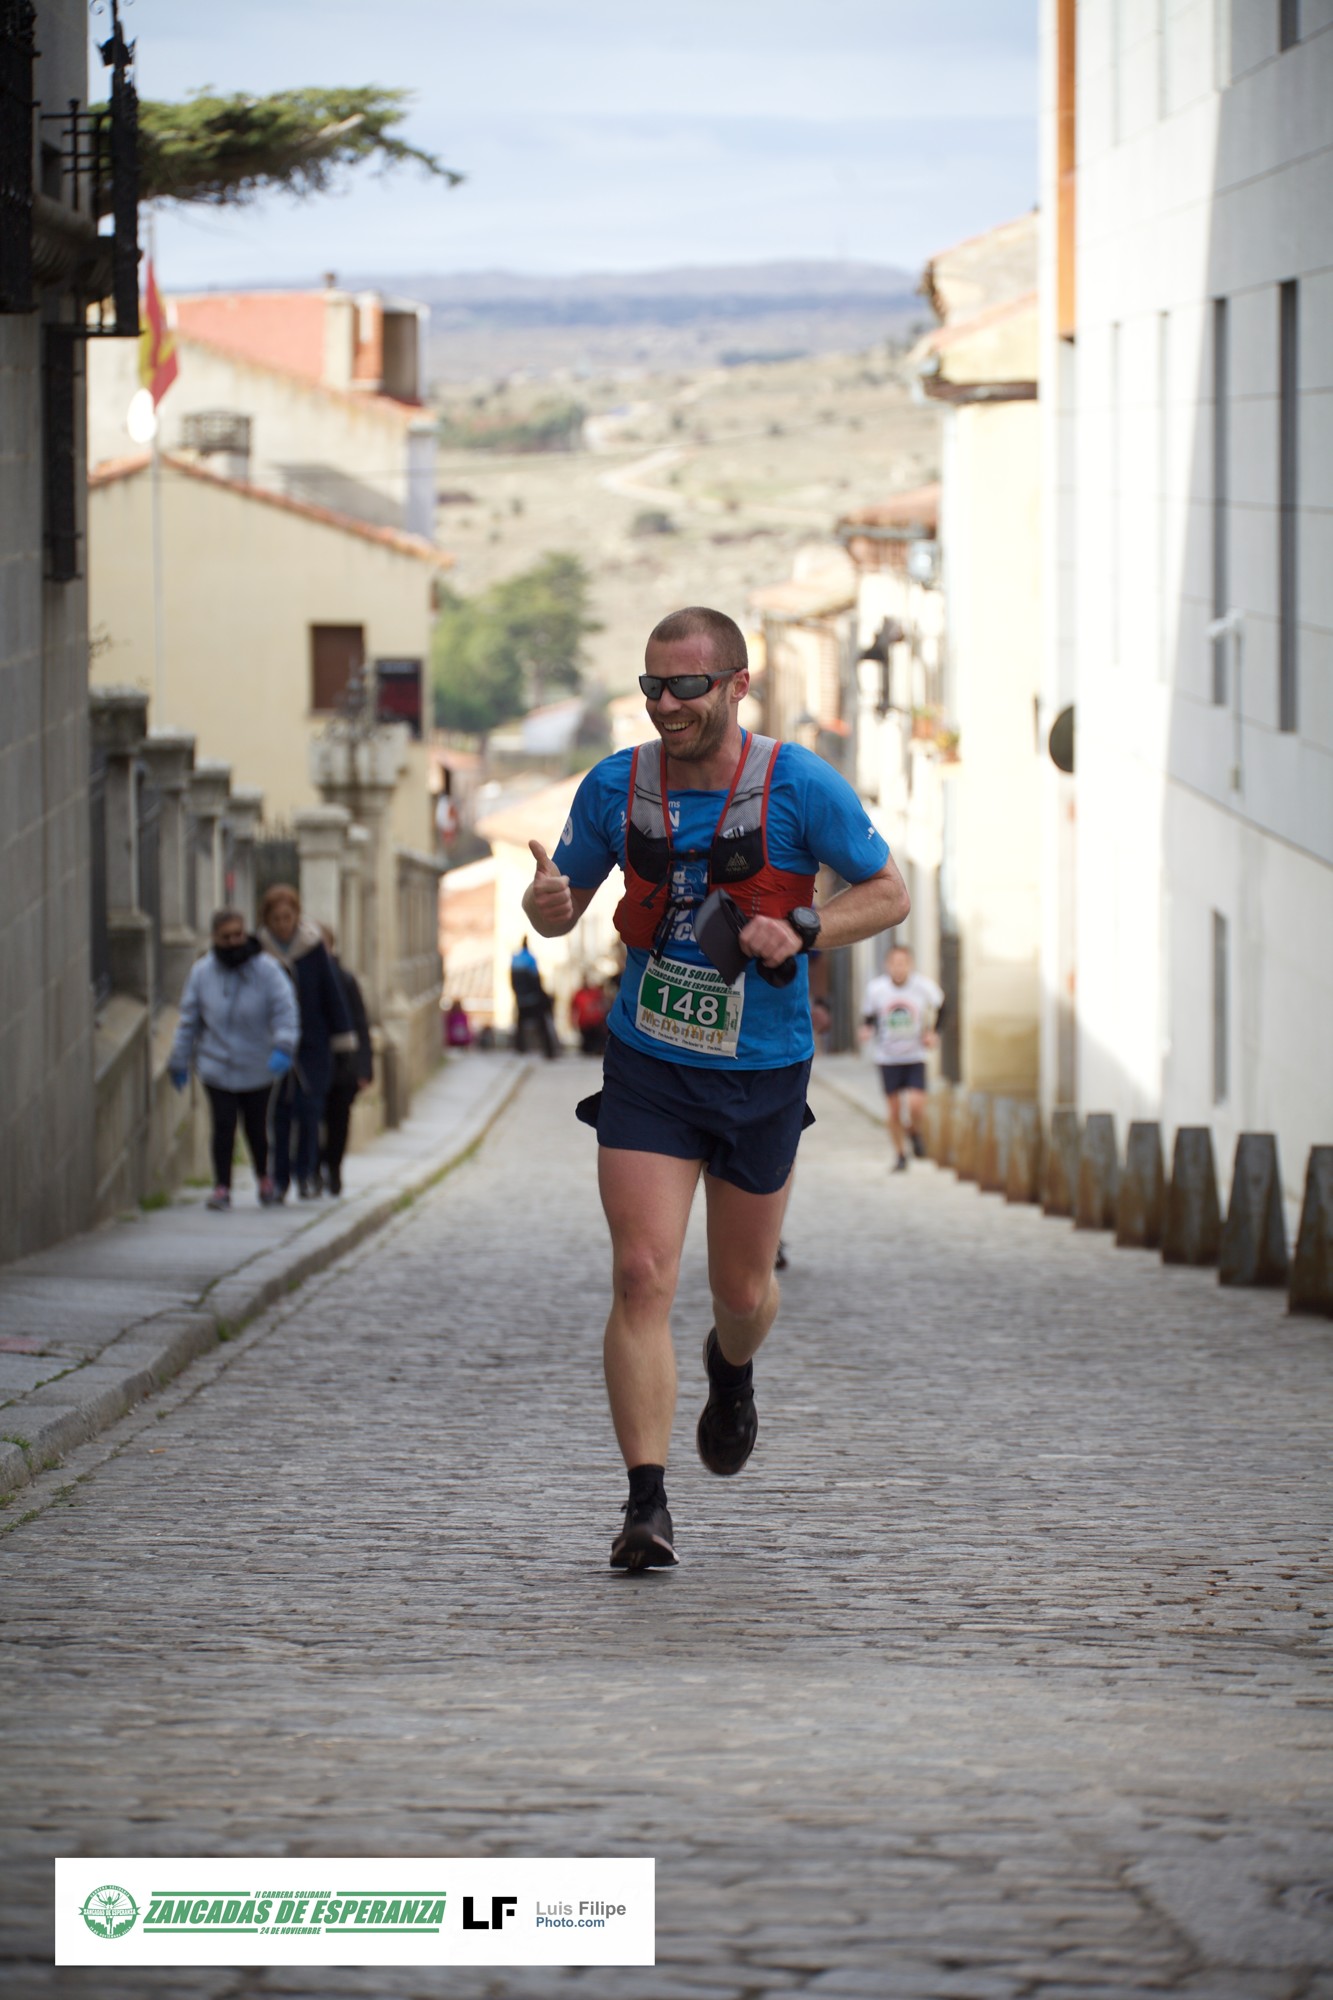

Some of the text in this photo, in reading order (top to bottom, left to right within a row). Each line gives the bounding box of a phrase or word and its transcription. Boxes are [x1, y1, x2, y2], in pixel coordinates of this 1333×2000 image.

[653, 958, 686, 977] RRERA
[688, 970, 727, 984] SOLIDA
[683, 980, 690, 988] DE
[691, 982, 728, 994] ESPERANZA
[657, 984, 719, 1026] 148
